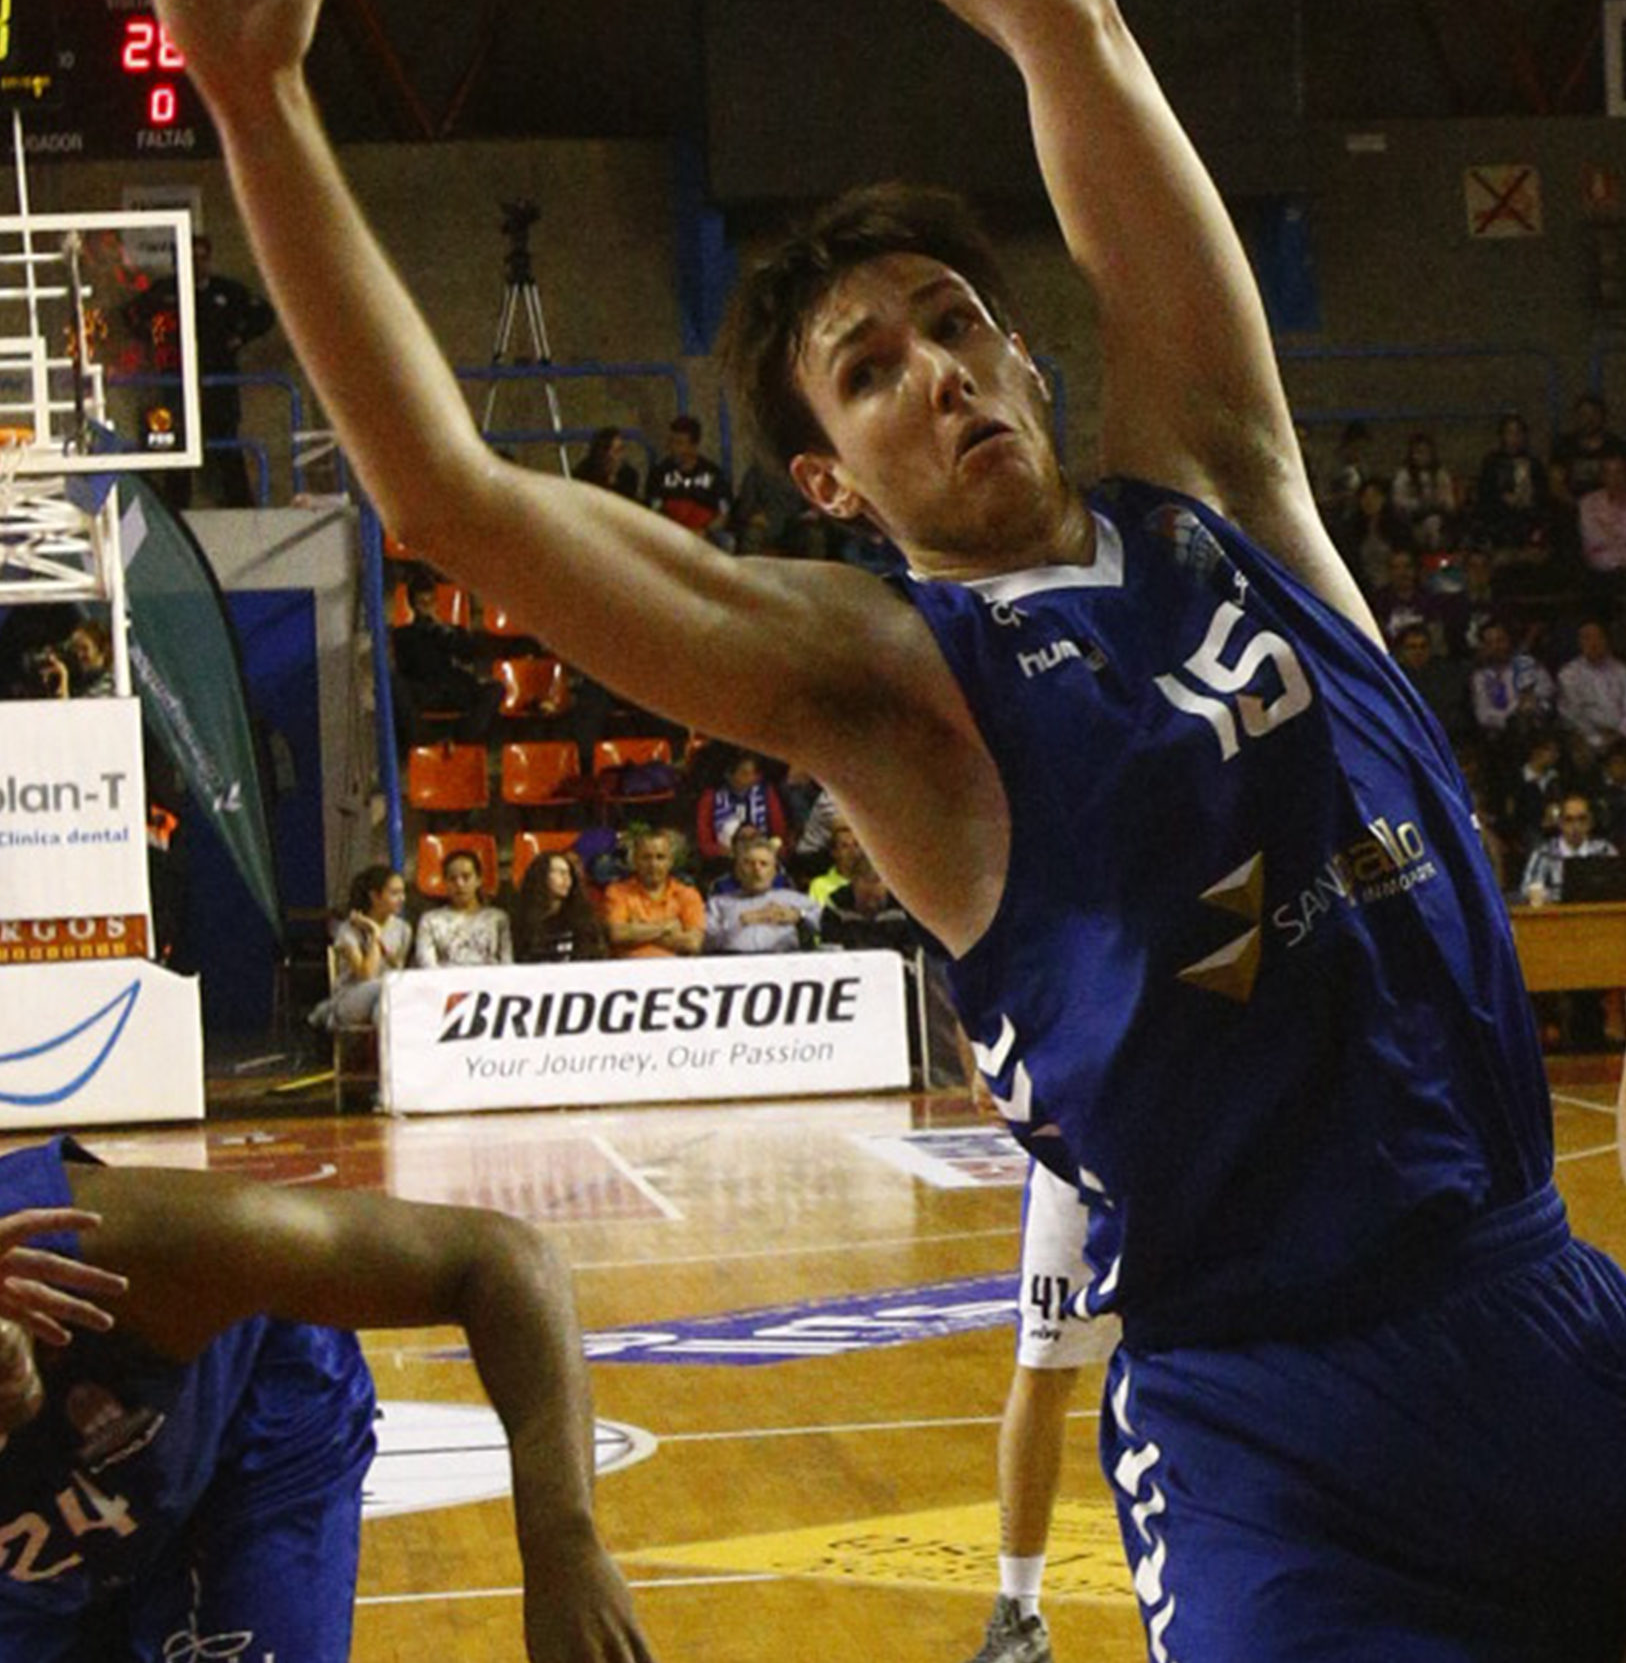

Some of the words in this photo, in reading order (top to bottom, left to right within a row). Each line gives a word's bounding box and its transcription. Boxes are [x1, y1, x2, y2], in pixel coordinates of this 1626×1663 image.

[1152, 600, 1314, 763] 15
[66, 826, 130, 844] dental
[437, 976, 862, 1043] BRIDGESTONE
[465, 1056, 527, 1080] Your
[668, 1043, 723, 1069] Our
[730, 1039, 835, 1066] Passion
[1030, 1273, 1070, 1321] 41
[0, 1471, 138, 1581] 24
